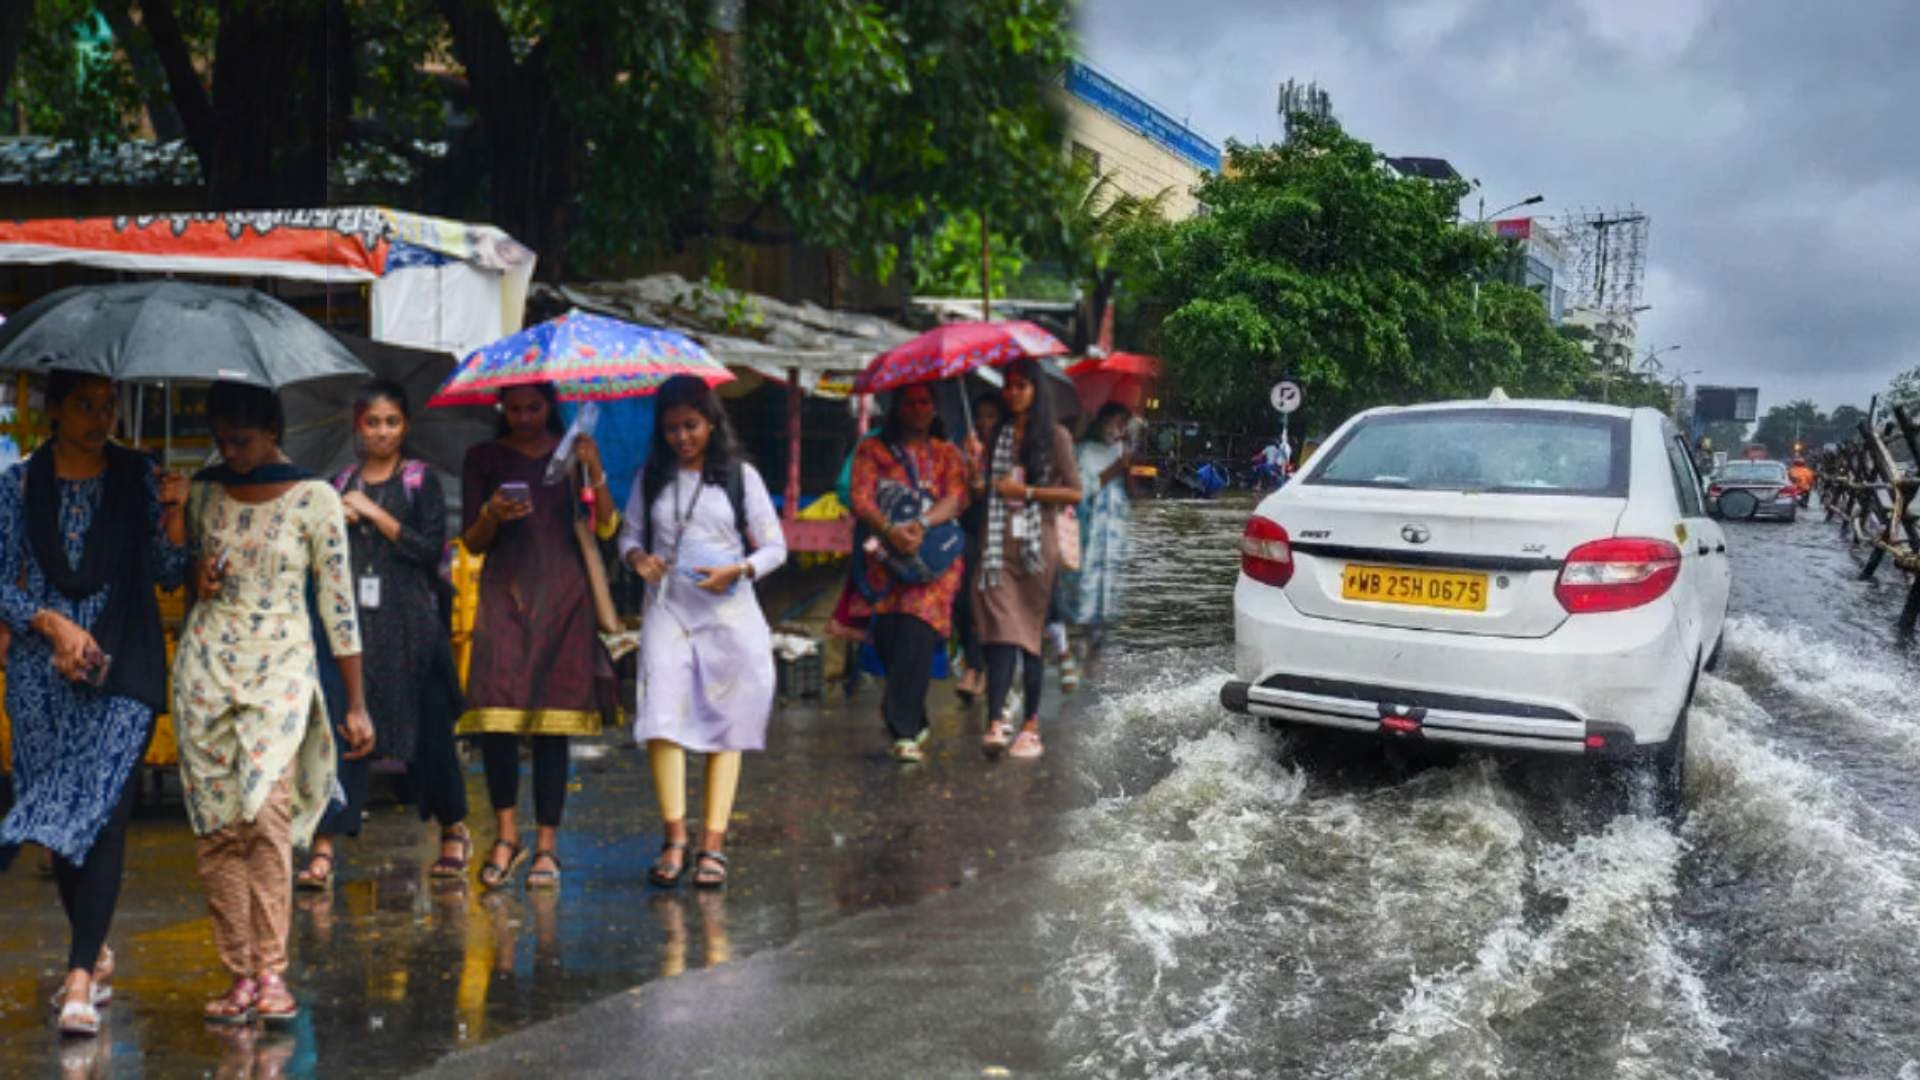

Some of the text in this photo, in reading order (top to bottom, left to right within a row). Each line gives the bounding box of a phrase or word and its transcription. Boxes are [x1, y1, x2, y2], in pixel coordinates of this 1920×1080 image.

[1358, 572, 1481, 604] WB 25H 0675
